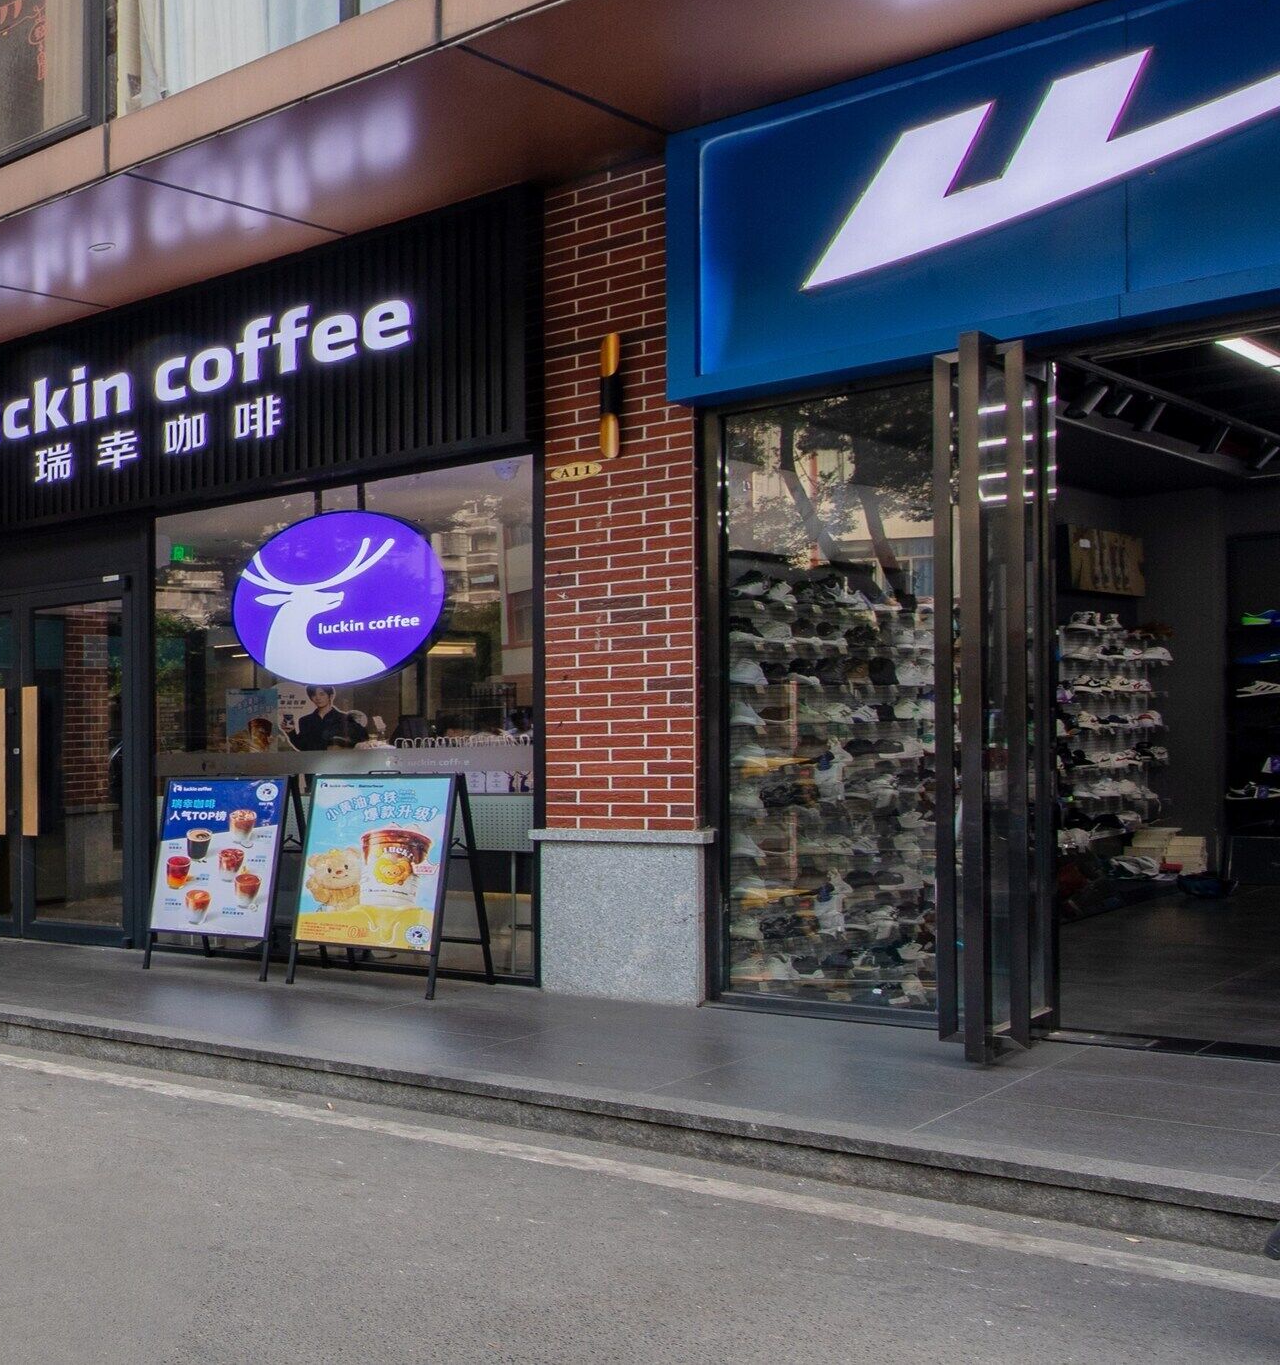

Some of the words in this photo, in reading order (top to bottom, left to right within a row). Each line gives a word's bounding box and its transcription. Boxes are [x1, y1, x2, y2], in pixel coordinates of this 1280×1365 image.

[154, 297, 413, 405] coffee
[33, 395, 285, 484] 瑞幸咖啡
[560, 464, 591, 479] A11
[318, 616, 365, 635] luckin
[368, 614, 420, 631] coffee
[171, 799, 216, 809] 瑞幸咖啡
[169, 810, 227, 822] 人气TOP榜
